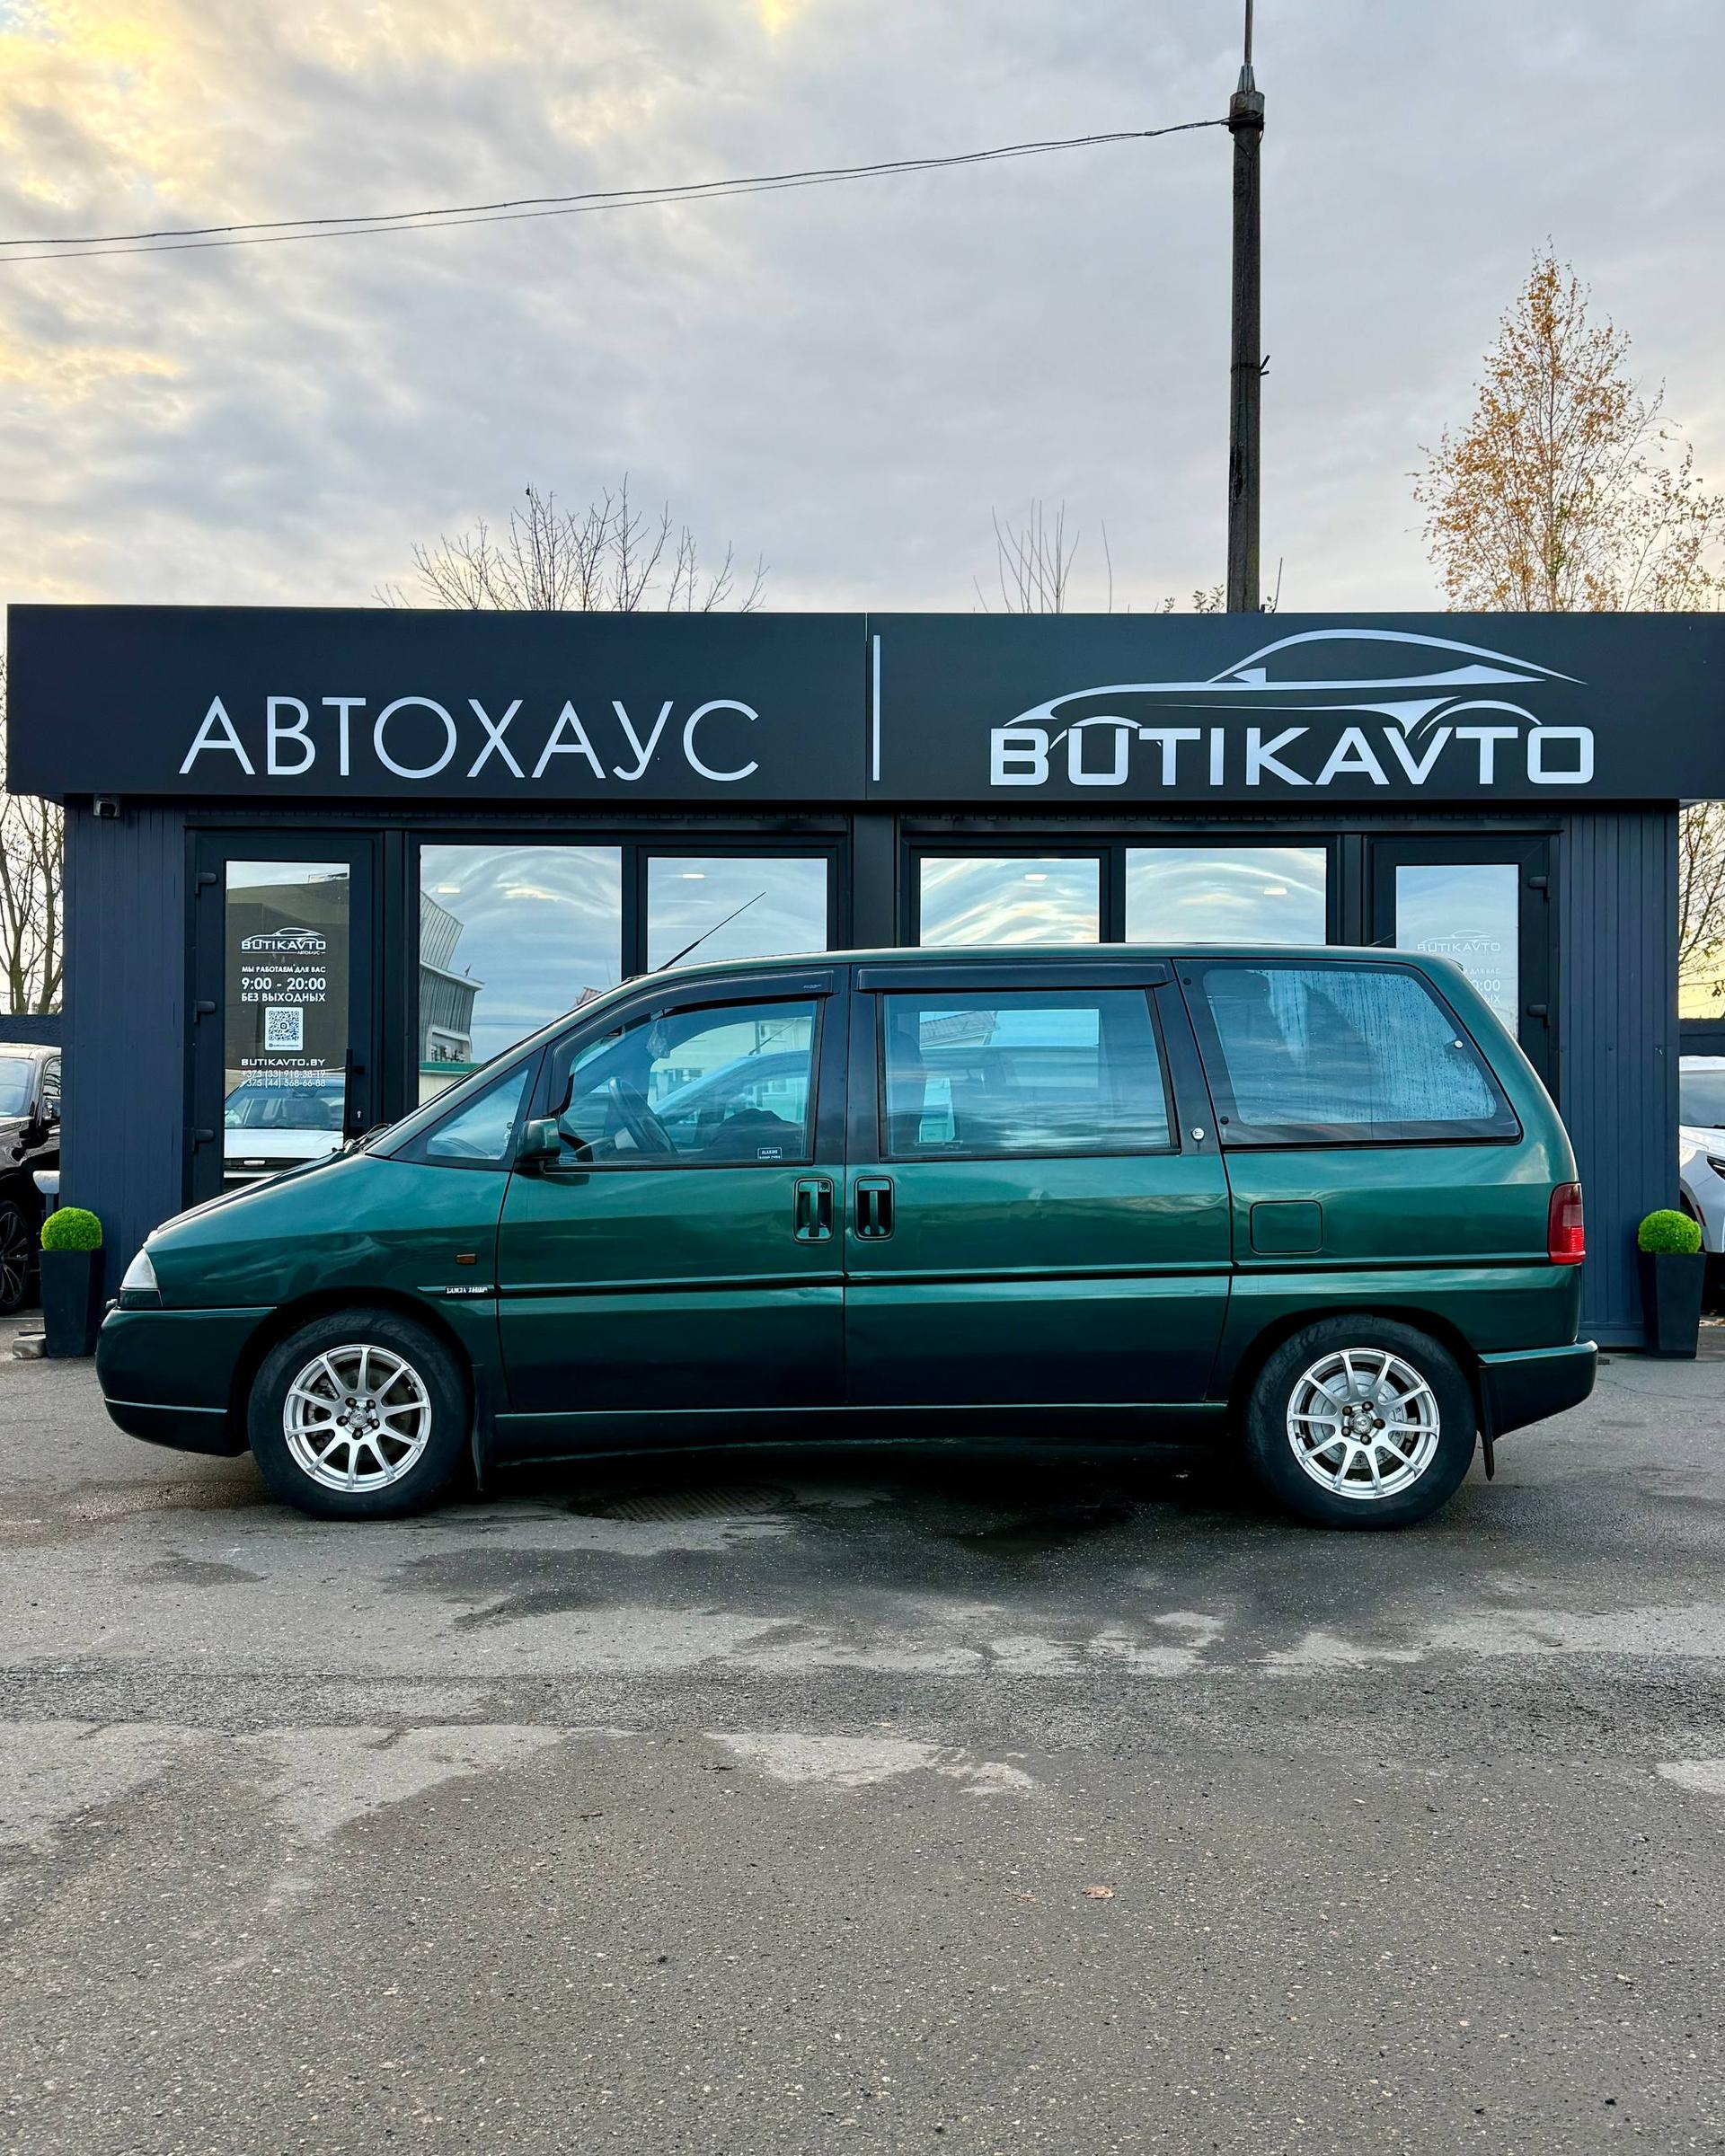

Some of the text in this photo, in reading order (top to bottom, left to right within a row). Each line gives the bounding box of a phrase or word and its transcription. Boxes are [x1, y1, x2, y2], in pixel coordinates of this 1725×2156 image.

[179, 695, 760, 782] АВТОХАУС
[990, 725, 1595, 786] BUTIKAVTO
[241, 941, 326, 950] BUTIKAVTO
[1417, 942, 1500, 952] BUTIKAVTO
[241, 976, 272, 990] 9:00
[287, 977, 326, 991] 20:00
[1472, 978, 1500, 992] 0:00
[241, 993, 325, 1003] БЕЗ ВЫХОДНЫХ
[241, 1058, 325, 1066] BUTIKAVTO.BY
[265, 1069, 281, 1079] (33)
[283, 1069, 326, 1078] 918-38-19
[265, 1078, 281, 1088] (44)
[283, 1079, 326, 1087] 568-66-88
